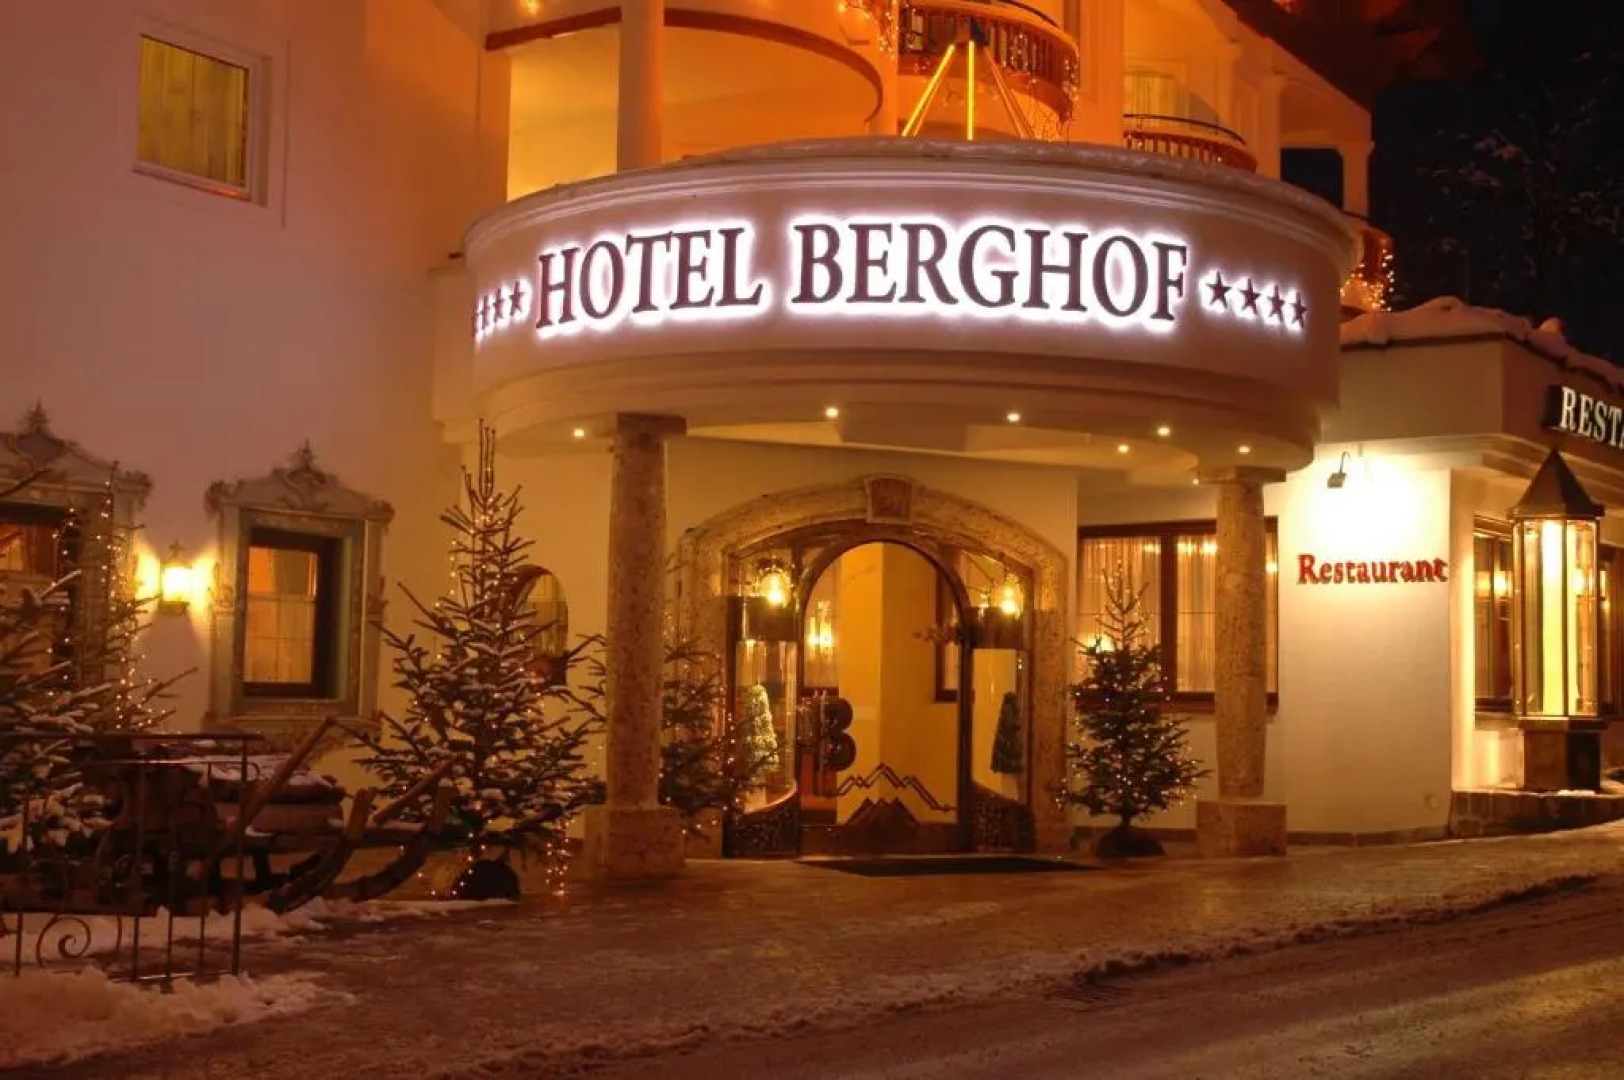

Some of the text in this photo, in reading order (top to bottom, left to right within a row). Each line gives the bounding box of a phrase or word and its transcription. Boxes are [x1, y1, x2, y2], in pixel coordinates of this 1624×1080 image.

[536, 222, 1187, 329] HOTEL BERGHOF
[1297, 553, 1449, 585] Restaurant
